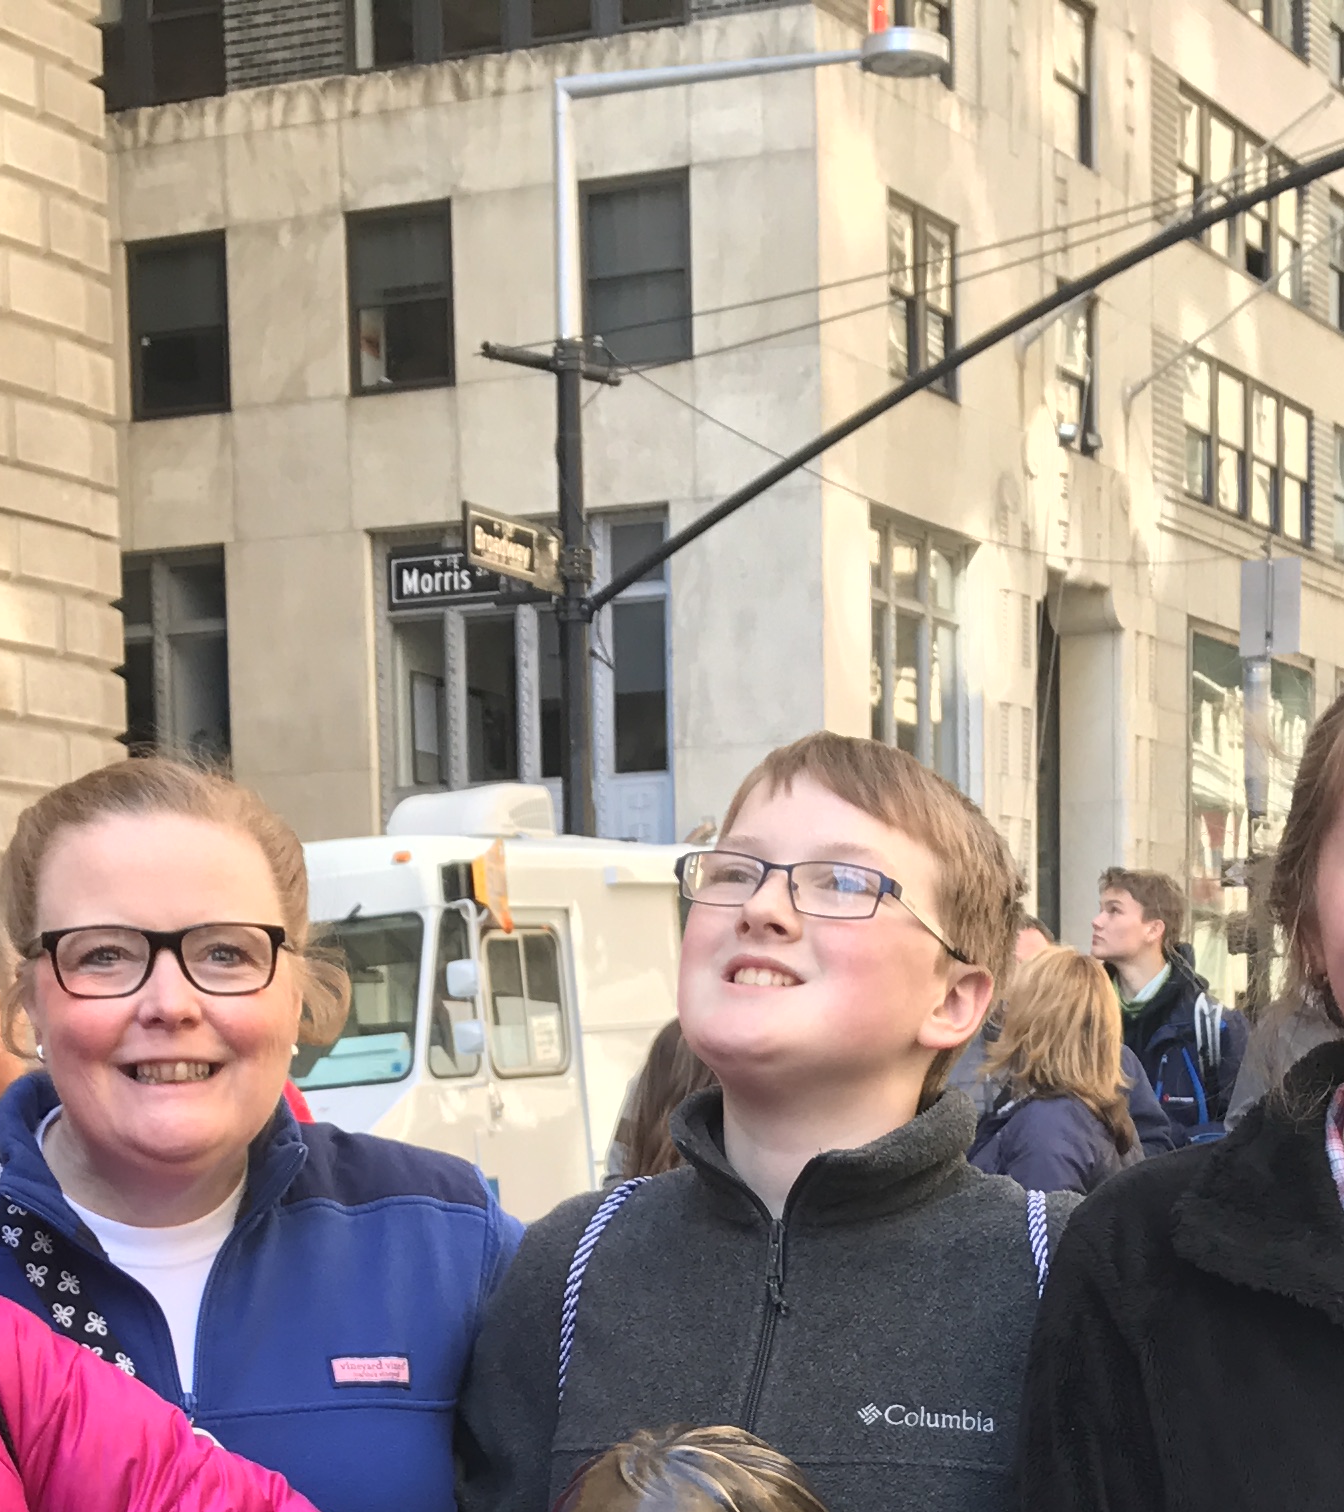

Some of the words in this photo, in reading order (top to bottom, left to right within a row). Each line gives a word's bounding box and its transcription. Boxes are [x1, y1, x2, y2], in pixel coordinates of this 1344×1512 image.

[402, 567, 472, 596] Morris
[340, 1360, 384, 1373] vineyard
[884, 1404, 994, 1433] Columbia
